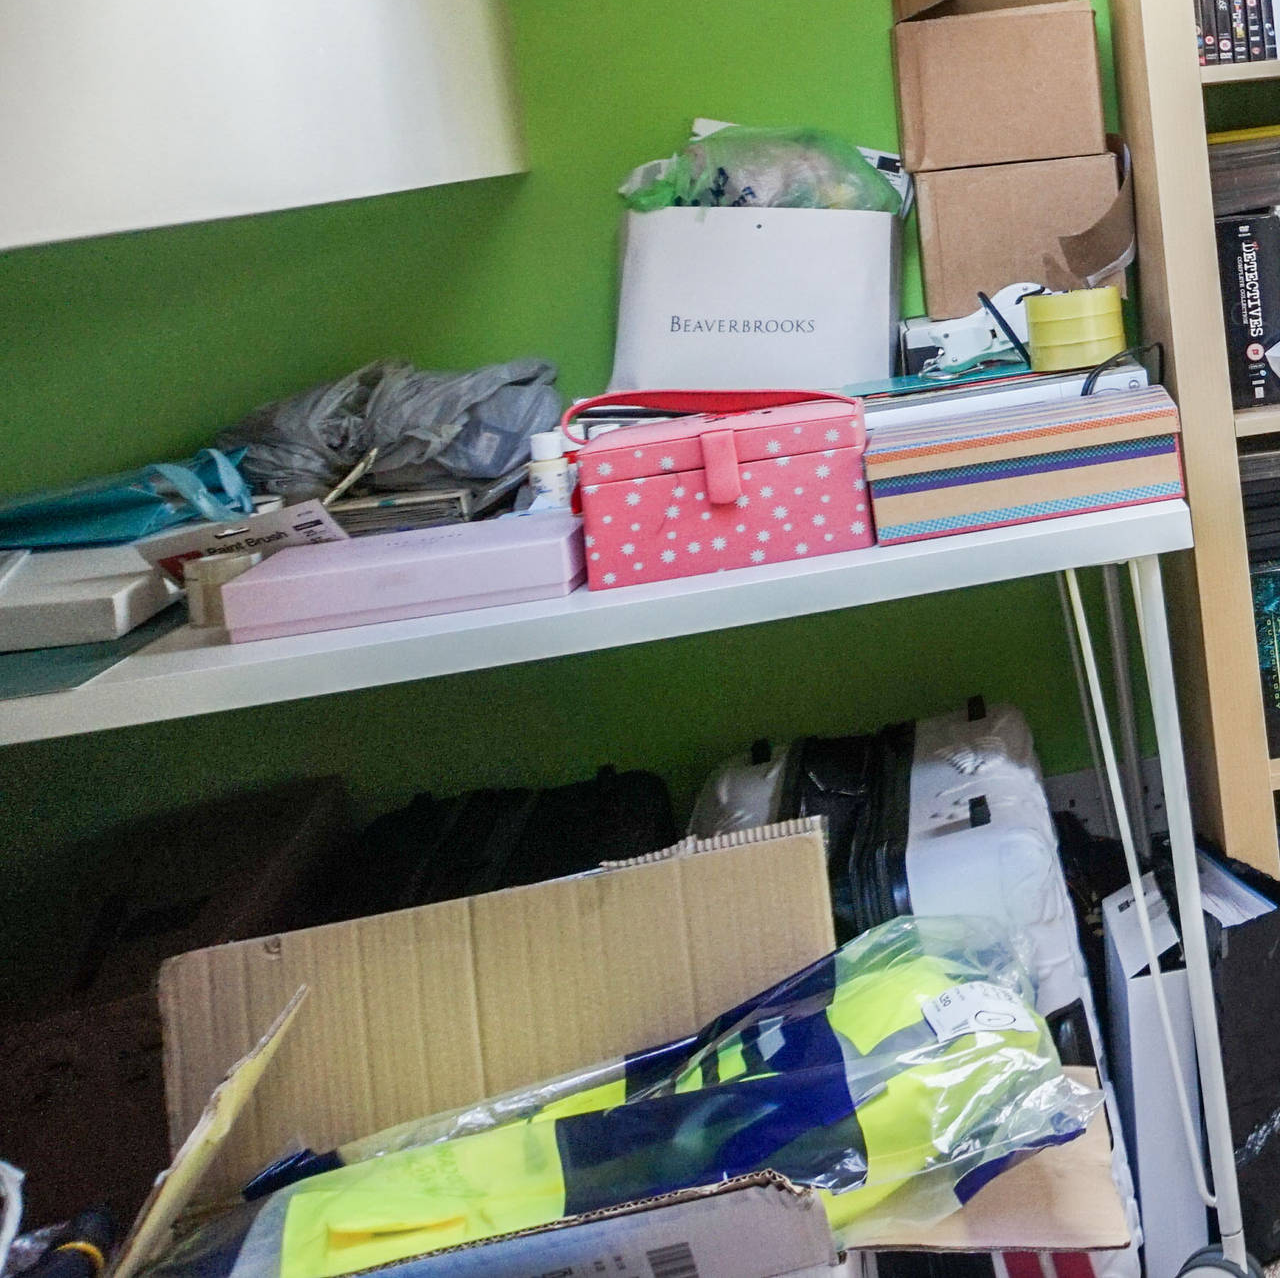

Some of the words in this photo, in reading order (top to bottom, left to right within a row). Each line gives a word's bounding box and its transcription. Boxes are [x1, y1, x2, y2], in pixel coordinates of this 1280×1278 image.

[1242, 241, 1264, 337] DETECTIVES
[669, 315, 816, 335] BEAVERBROOKS
[207, 541, 245, 555] Paint
[246, 531, 288, 548] Brush
